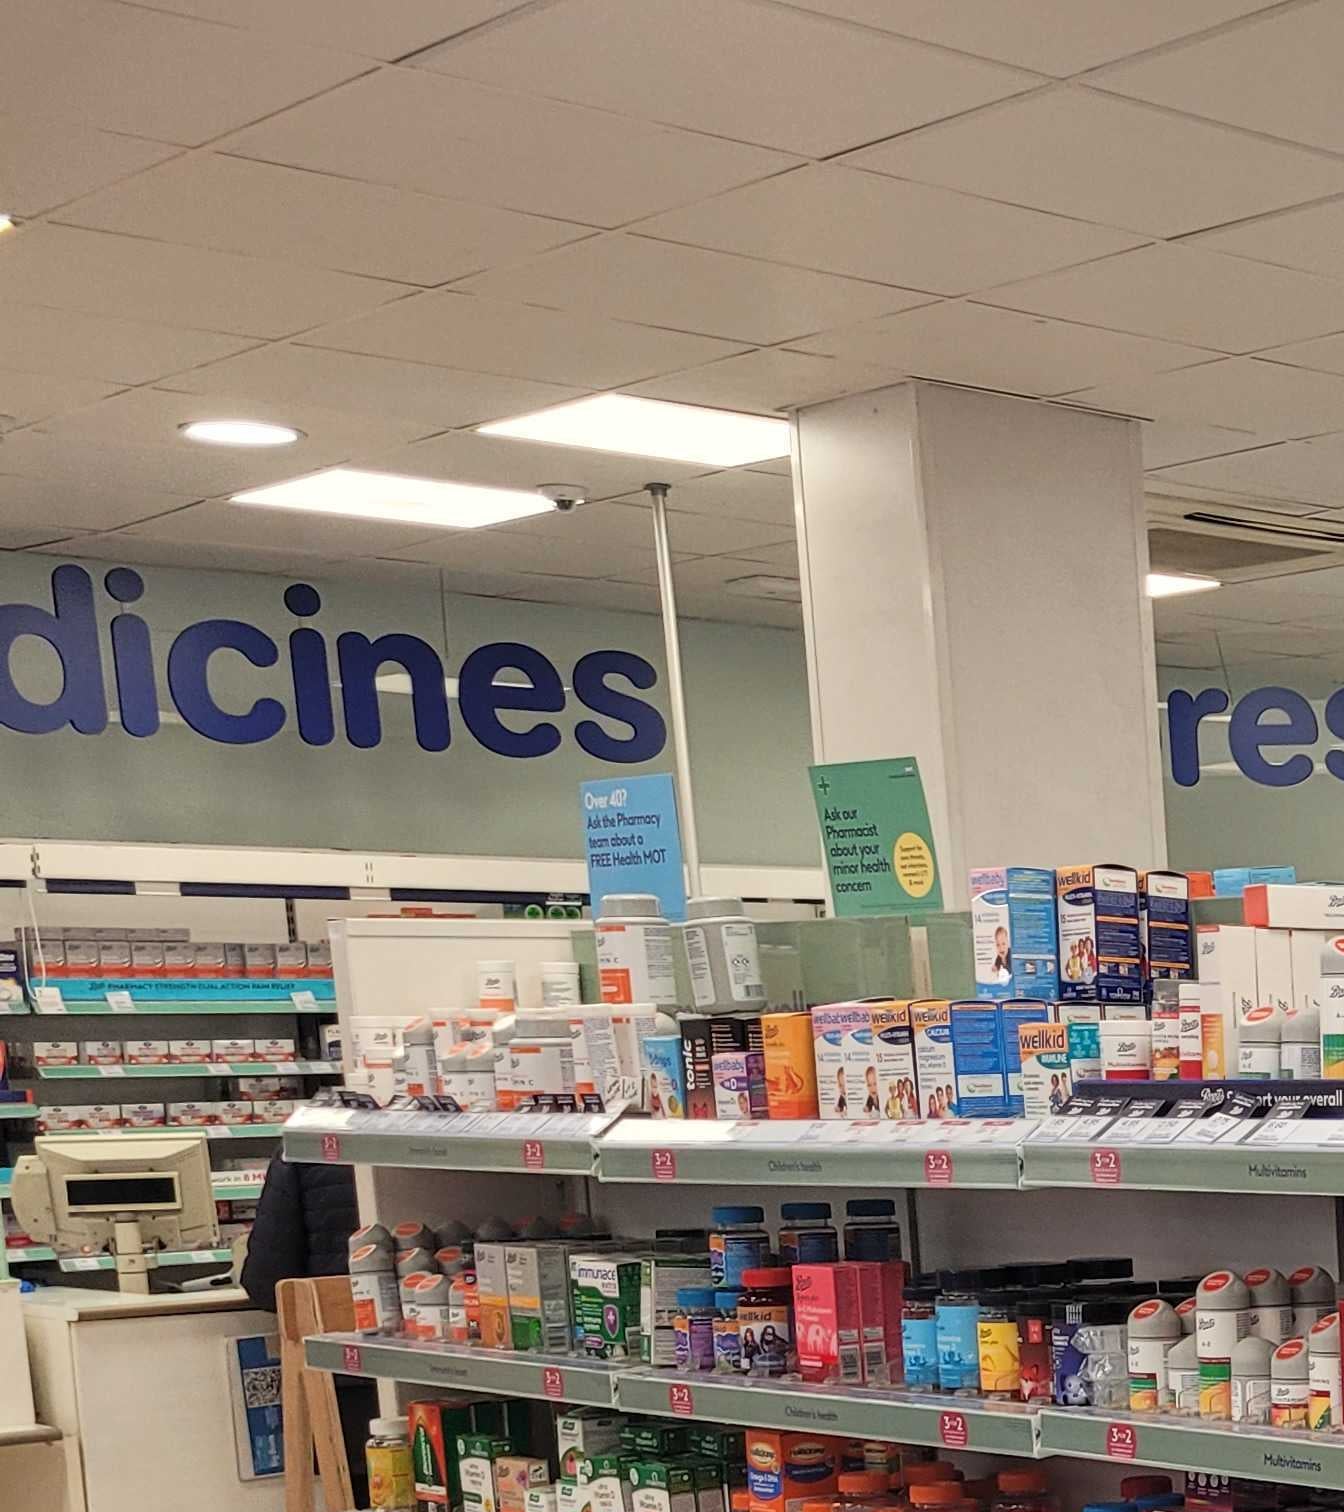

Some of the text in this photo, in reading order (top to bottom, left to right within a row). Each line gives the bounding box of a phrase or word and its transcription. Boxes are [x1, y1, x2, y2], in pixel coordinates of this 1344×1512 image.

[0, 564, 667, 763] dicines
[585, 788, 627, 809] Over 40?
[587, 812, 661, 829] Ask the Pharmacy
[824, 808, 857, 822] Ask our
[826, 825, 878, 838] Pharmacist
[589, 833, 635, 848] team about
[591, 849, 666, 867] FREE Health MOT
[831, 844, 880, 861] about your
[833, 859, 891, 875] minor health
[836, 880, 872, 893] concern
[1020, 1031, 1065, 1050] wellkid
[1263, 1454, 1322, 1472] Multivitamins
